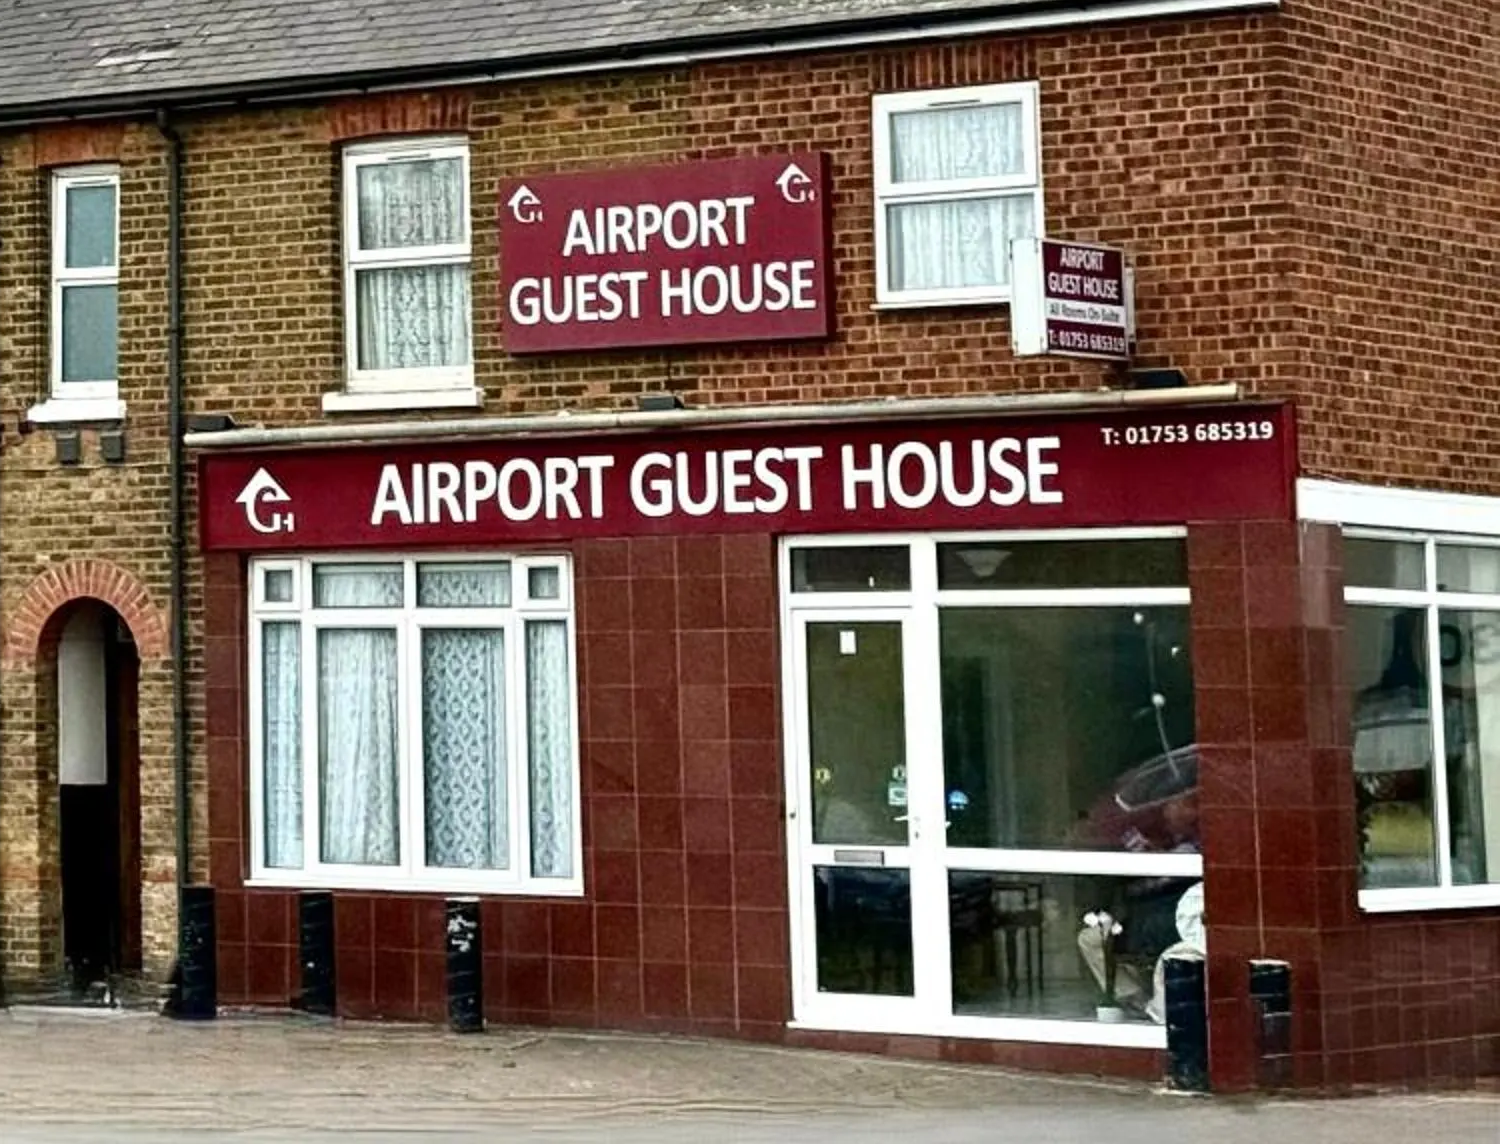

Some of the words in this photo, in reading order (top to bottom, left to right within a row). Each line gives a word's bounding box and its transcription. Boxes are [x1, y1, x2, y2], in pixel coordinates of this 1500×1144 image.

[563, 196, 755, 257] AIRPORT
[1059, 247, 1105, 271] AIRPORT
[509, 270, 649, 325] GUEST
[661, 259, 817, 317] HOUSE
[1048, 272, 1081, 295] GUEST
[1083, 276, 1119, 300] HOUSE
[1059, 330, 1089, 350] 01753
[1090, 333, 1125, 352] 685319
[1101, 427, 1121, 445] T:
[1125, 424, 1189, 445] 01753
[1194, 421, 1274, 442] 685319
[371, 456, 614, 525] AIRPORT
[629, 446, 823, 518] GUEST
[841, 436, 1064, 511] HOUSE
